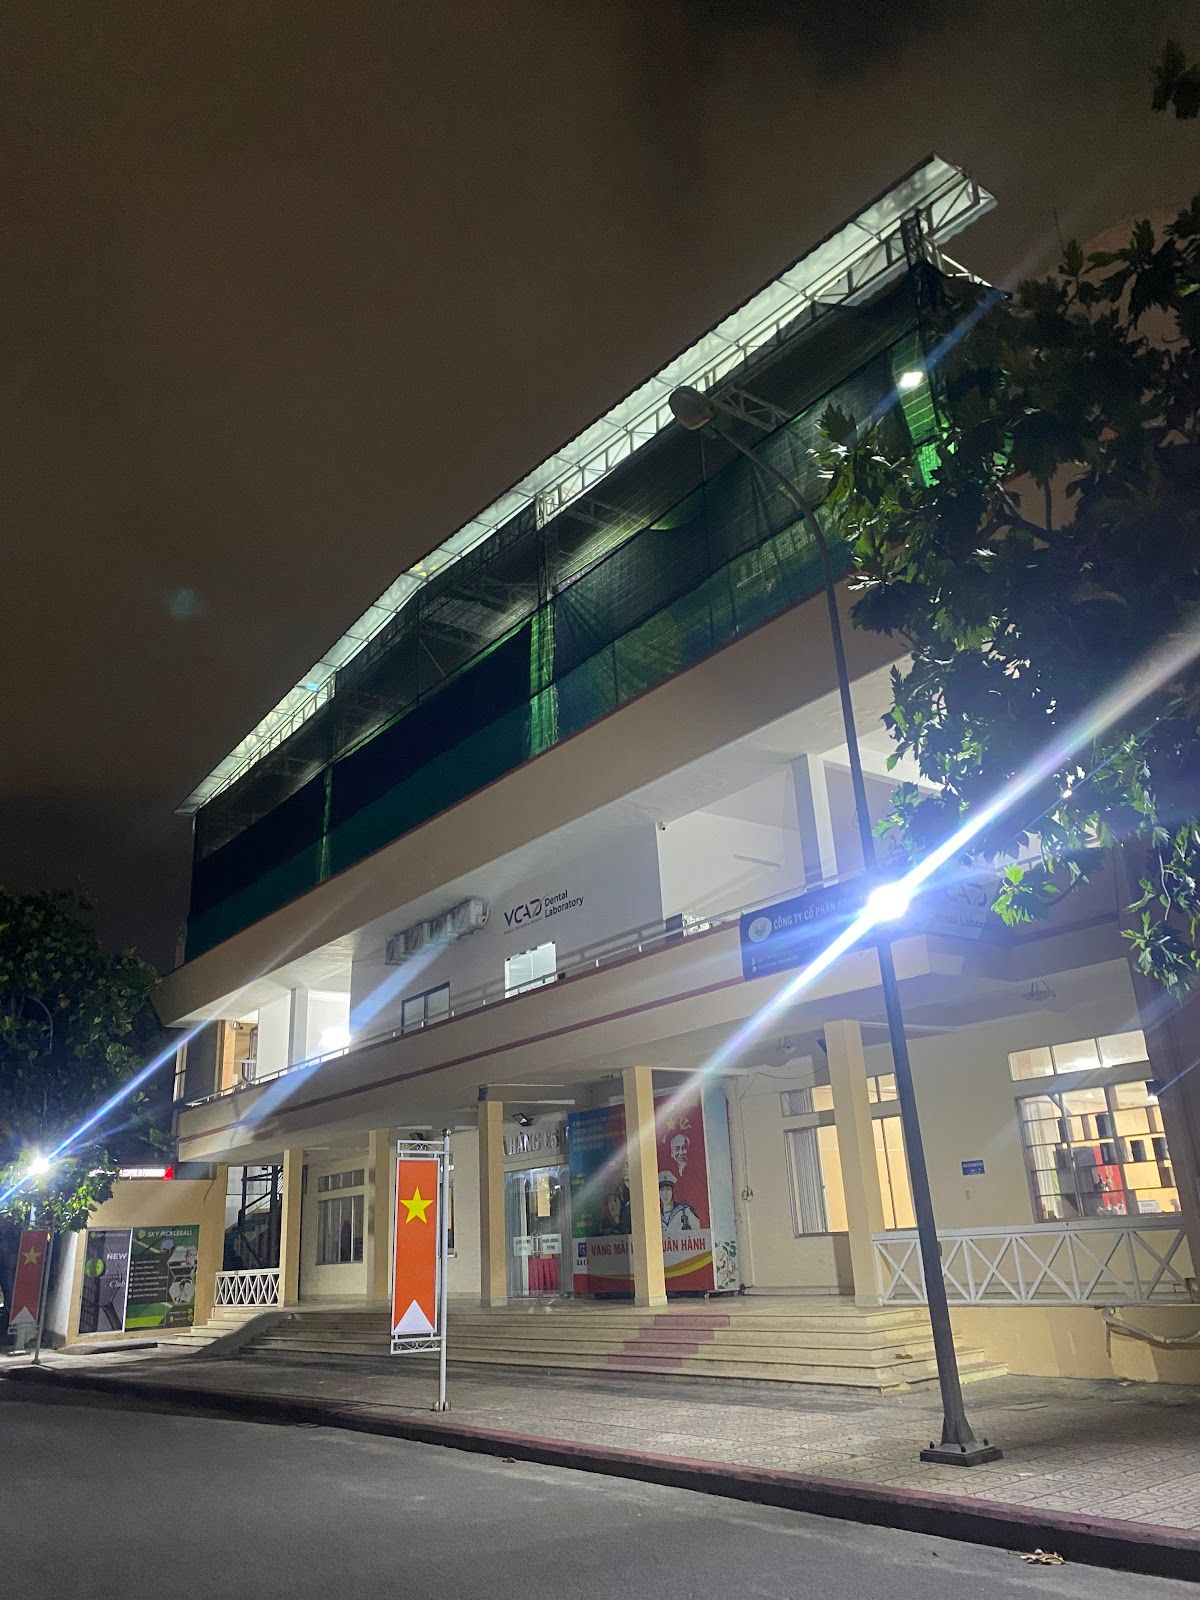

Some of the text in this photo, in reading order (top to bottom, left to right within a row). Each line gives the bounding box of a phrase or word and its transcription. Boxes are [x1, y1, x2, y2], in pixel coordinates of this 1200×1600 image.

[544, 889, 568, 907] Dental
[544, 897, 584, 918] Laboratory
[773, 916, 793, 930] CÔNG
[793, 912, 803, 923] TY
[106, 1252, 128, 1260] NEW
[591, 1243, 612, 1256] VANG
